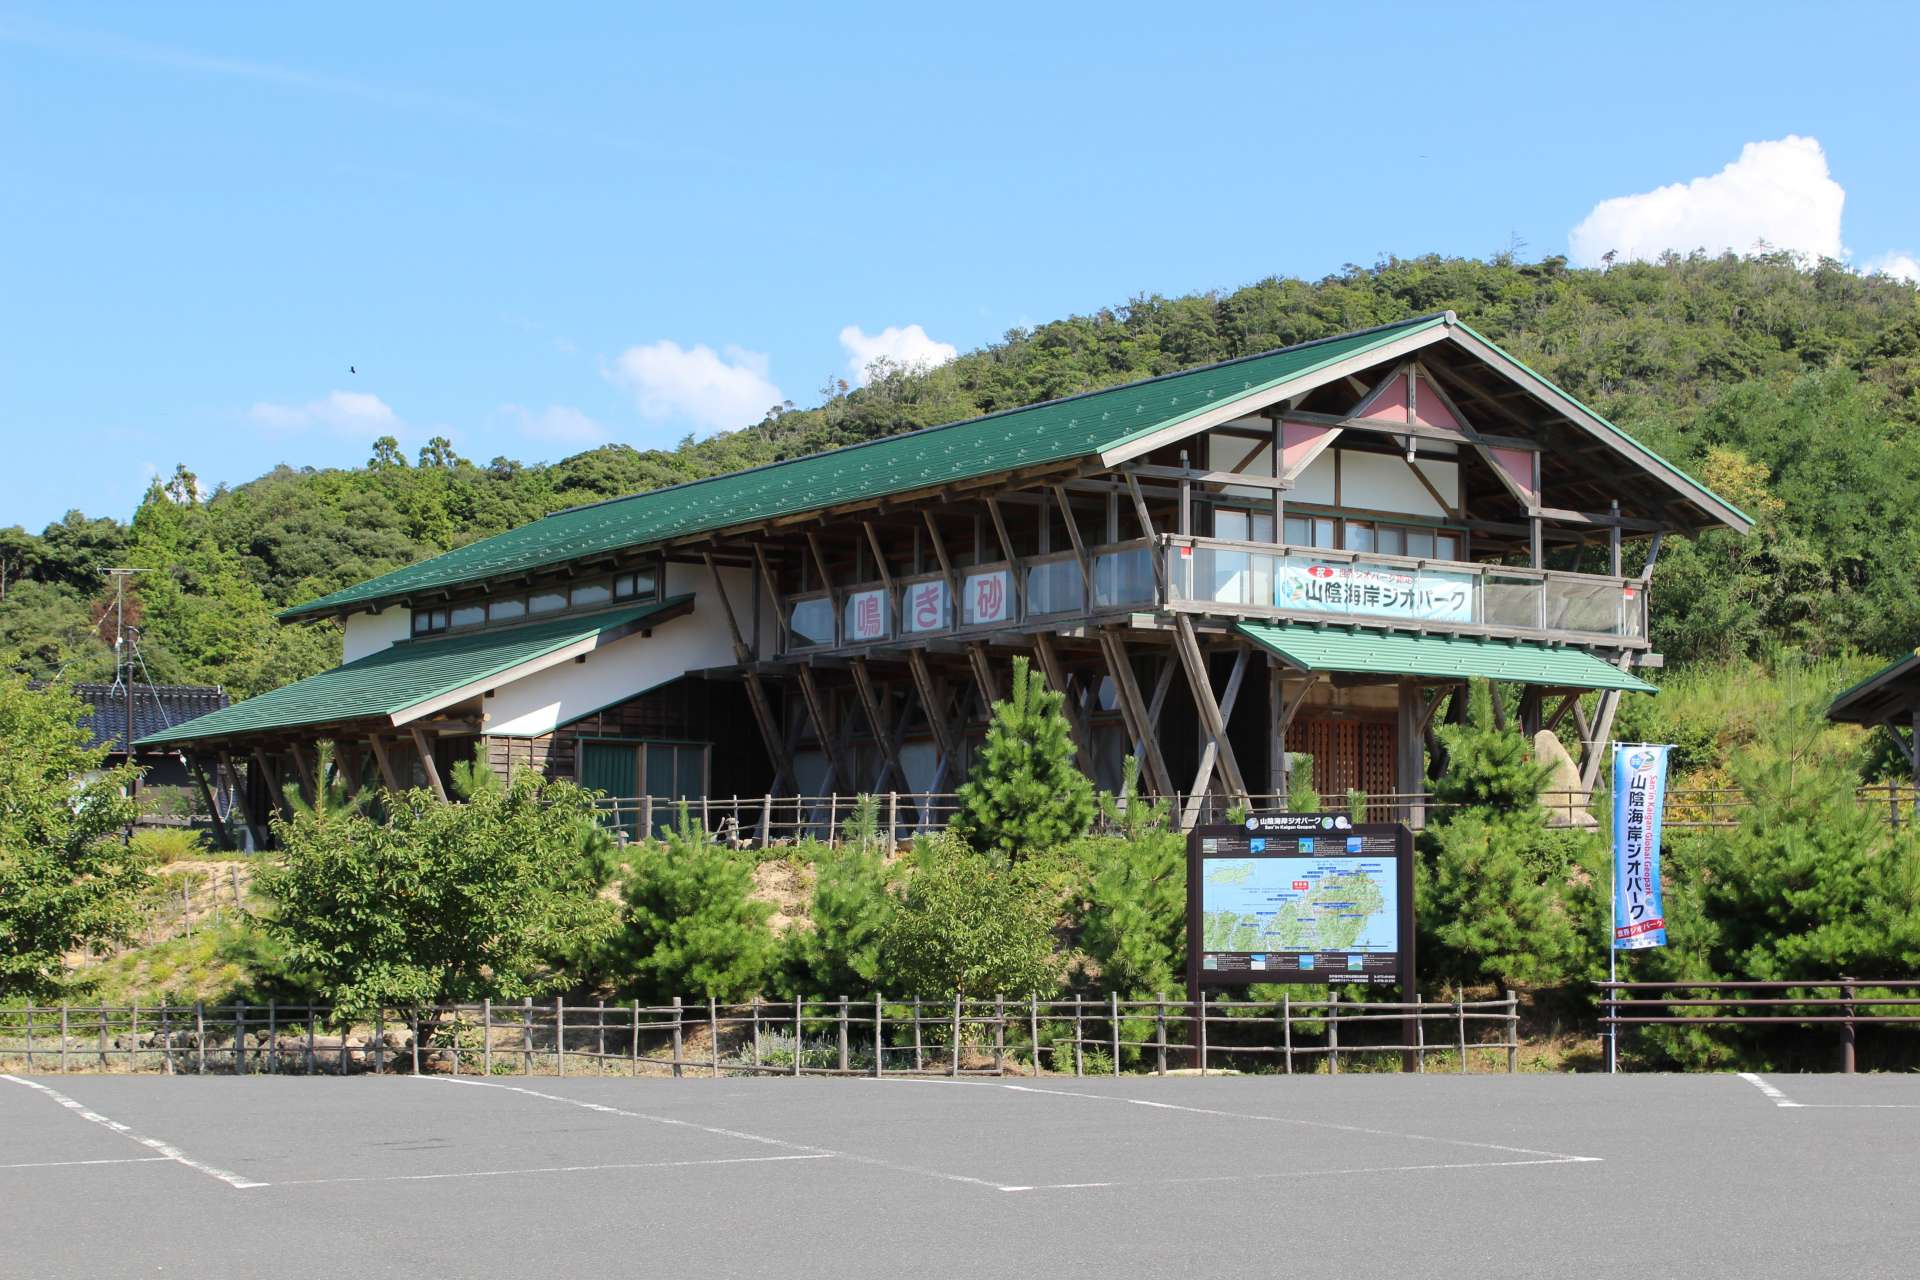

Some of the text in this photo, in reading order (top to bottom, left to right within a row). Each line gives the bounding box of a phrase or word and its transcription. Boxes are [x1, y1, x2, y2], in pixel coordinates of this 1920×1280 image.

[1305, 579, 1466, 612] 山陰海岸ジオパーク
[1260, 817, 1321, 825] 山陰海岸ジオパーク
[1644, 801, 1656, 831] Kaigan
[1626, 774, 1647, 920] 山陰海岸ジオパーク
[1644, 832, 1652, 859] Global
[1643, 861, 1653, 896] Geopark
